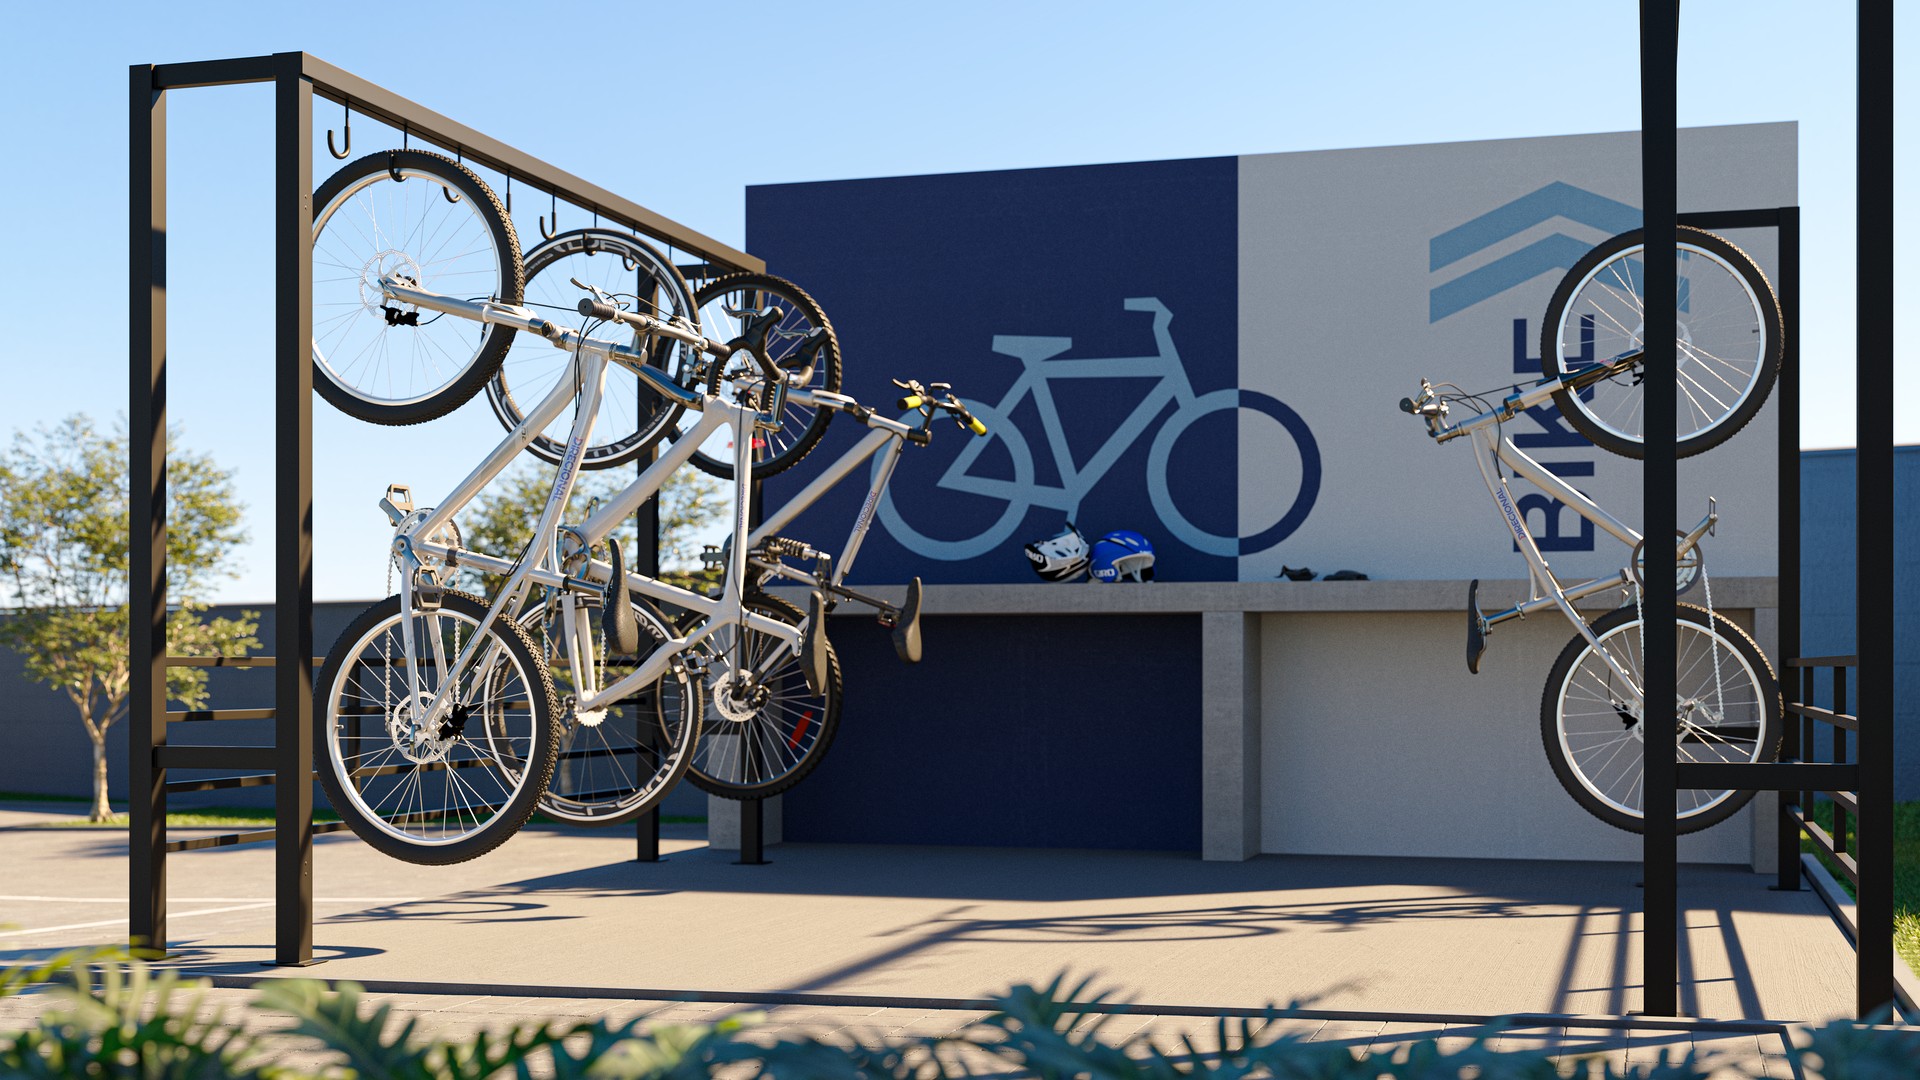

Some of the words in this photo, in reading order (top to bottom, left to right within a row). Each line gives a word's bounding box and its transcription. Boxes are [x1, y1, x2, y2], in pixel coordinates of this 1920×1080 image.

[1513, 314, 1594, 552] BIKE
[552, 436, 583, 501] DIRECIONAL
[854, 490, 877, 532] DIRECIONAL
[1496, 488, 1526, 541] DIRECIONAL
